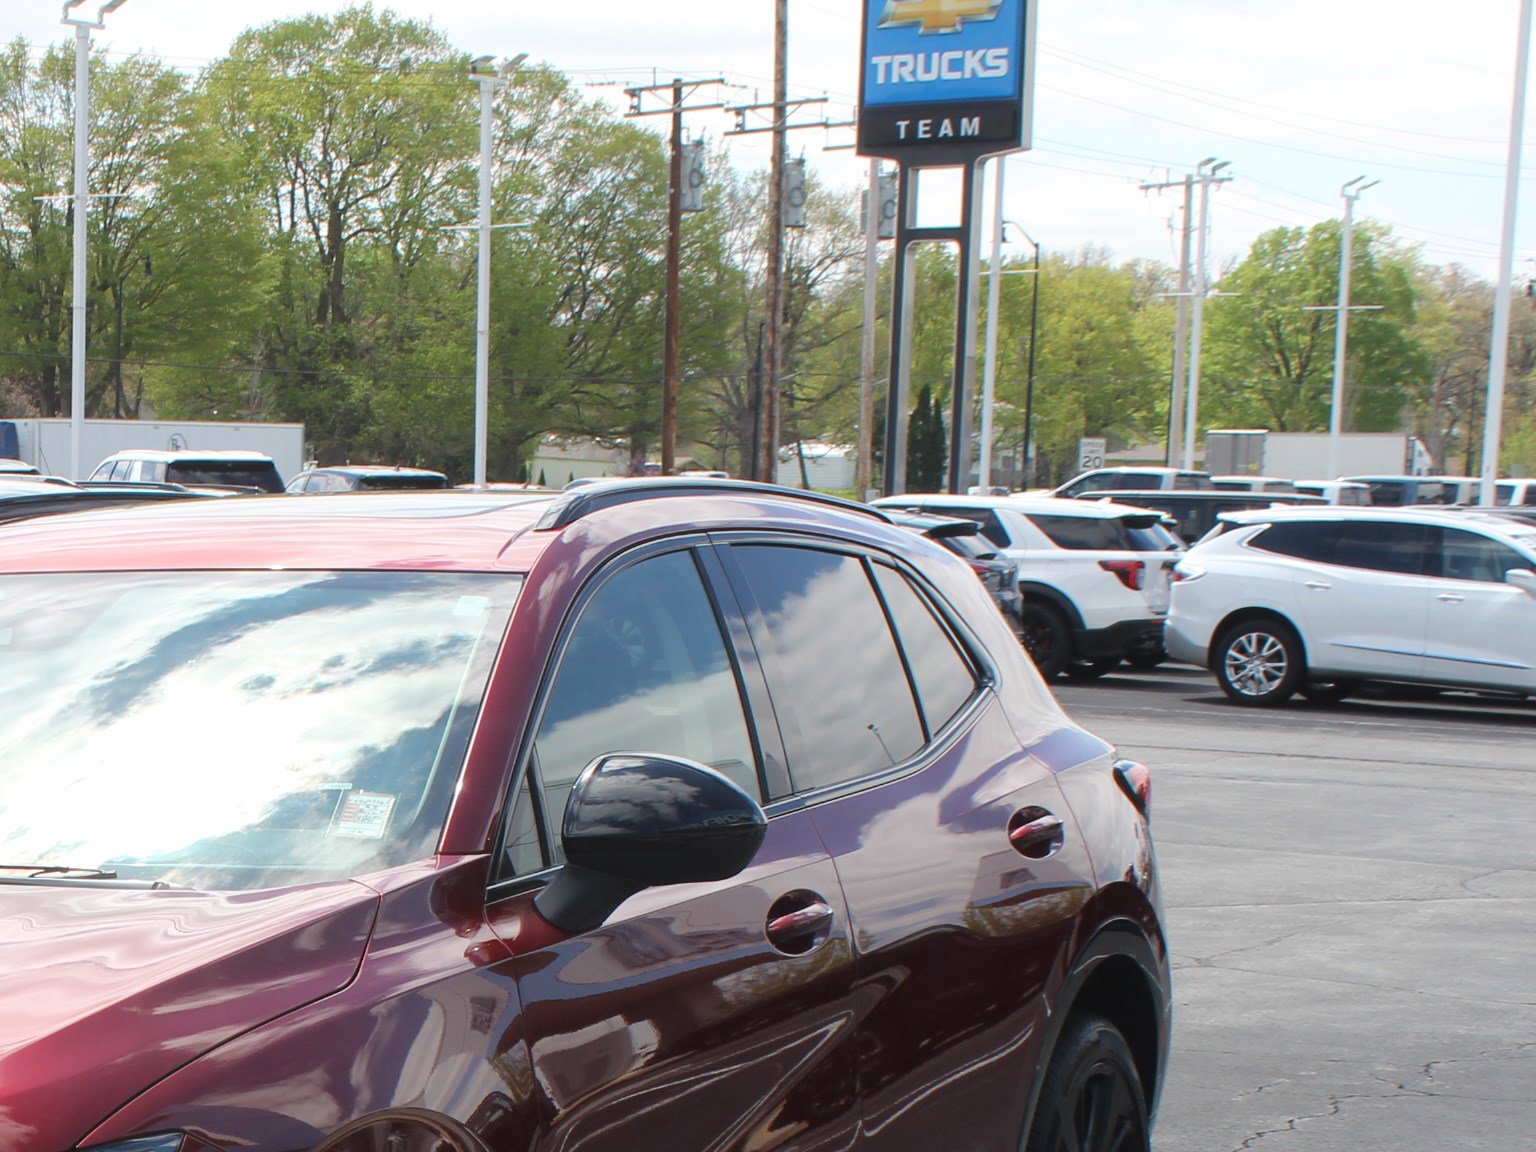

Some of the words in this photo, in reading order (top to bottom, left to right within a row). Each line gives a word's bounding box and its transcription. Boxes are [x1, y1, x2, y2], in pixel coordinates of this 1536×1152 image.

[871, 48, 1009, 84] TRUCKS
[896, 116, 981, 139] TEAM
[1082, 455, 1103, 468] 20
